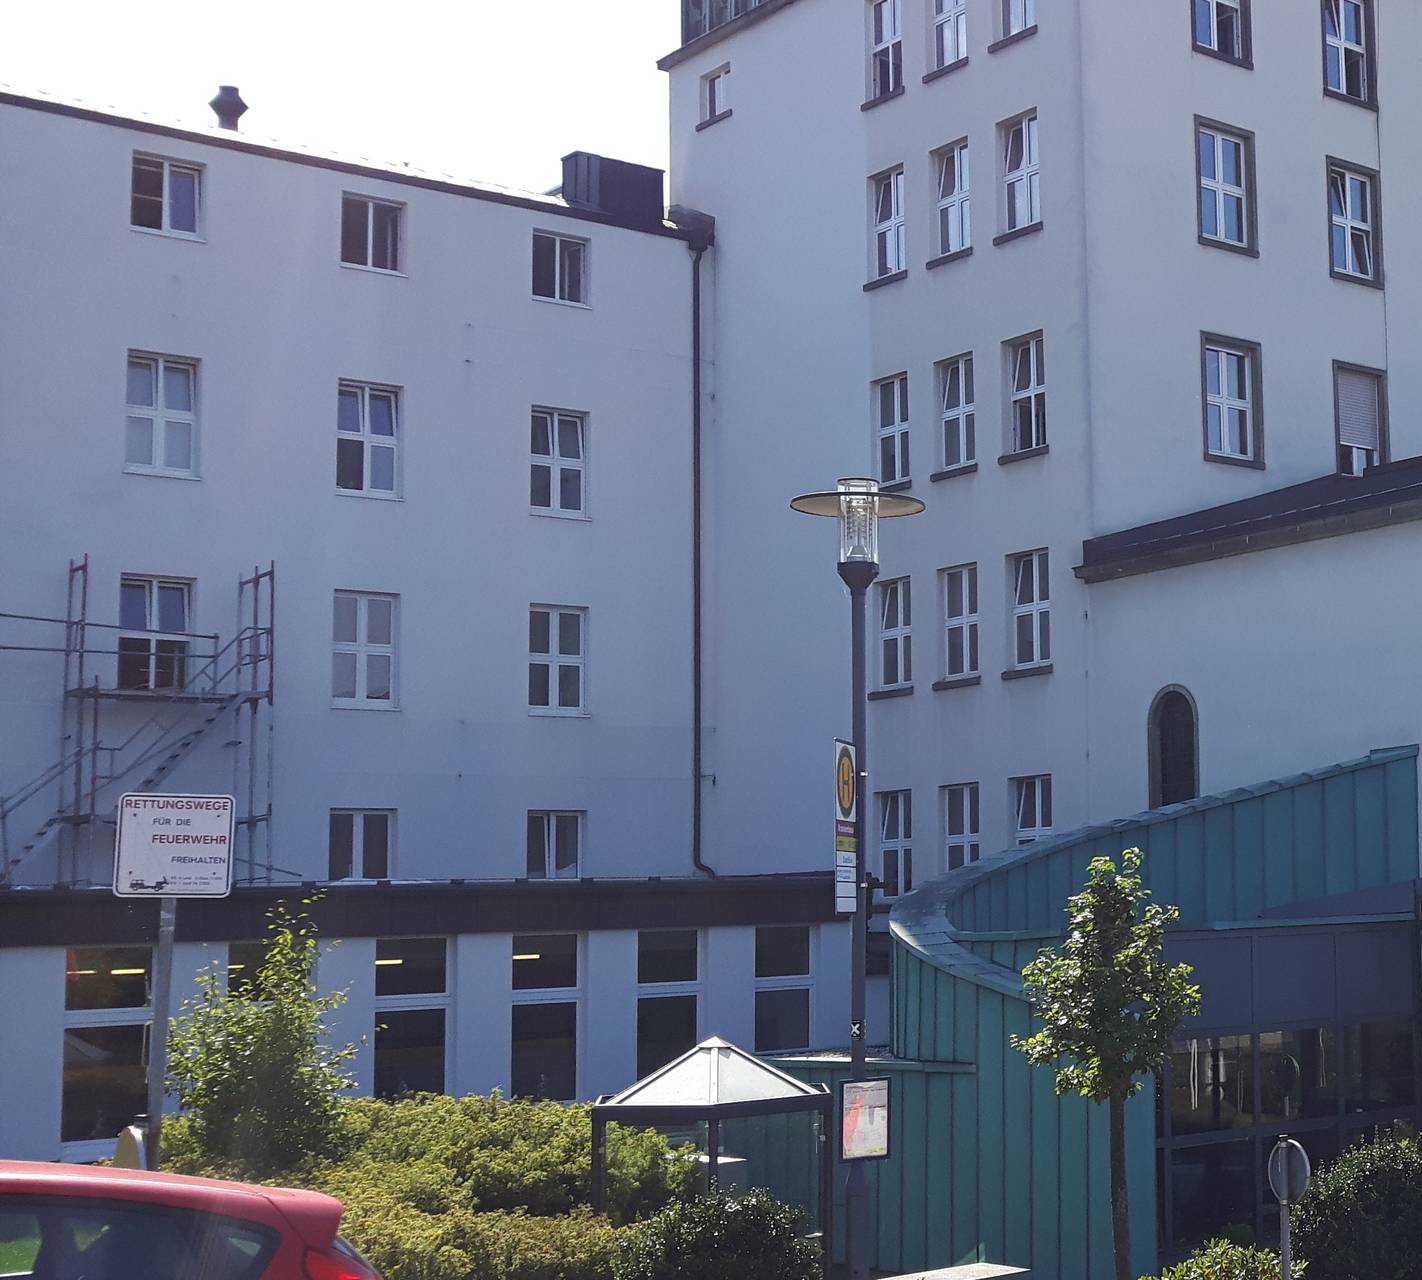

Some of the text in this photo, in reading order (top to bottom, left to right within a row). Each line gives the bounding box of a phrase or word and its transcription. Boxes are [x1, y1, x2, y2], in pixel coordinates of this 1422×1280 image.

[842, 762, 850, 801] H
[125, 799, 229, 811] RETTUNGSWEGE
[152, 817, 191, 826] FÜR DIE
[152, 834, 227, 845] FEUERWEHR
[171, 856, 226, 864] FREIHALTEN
